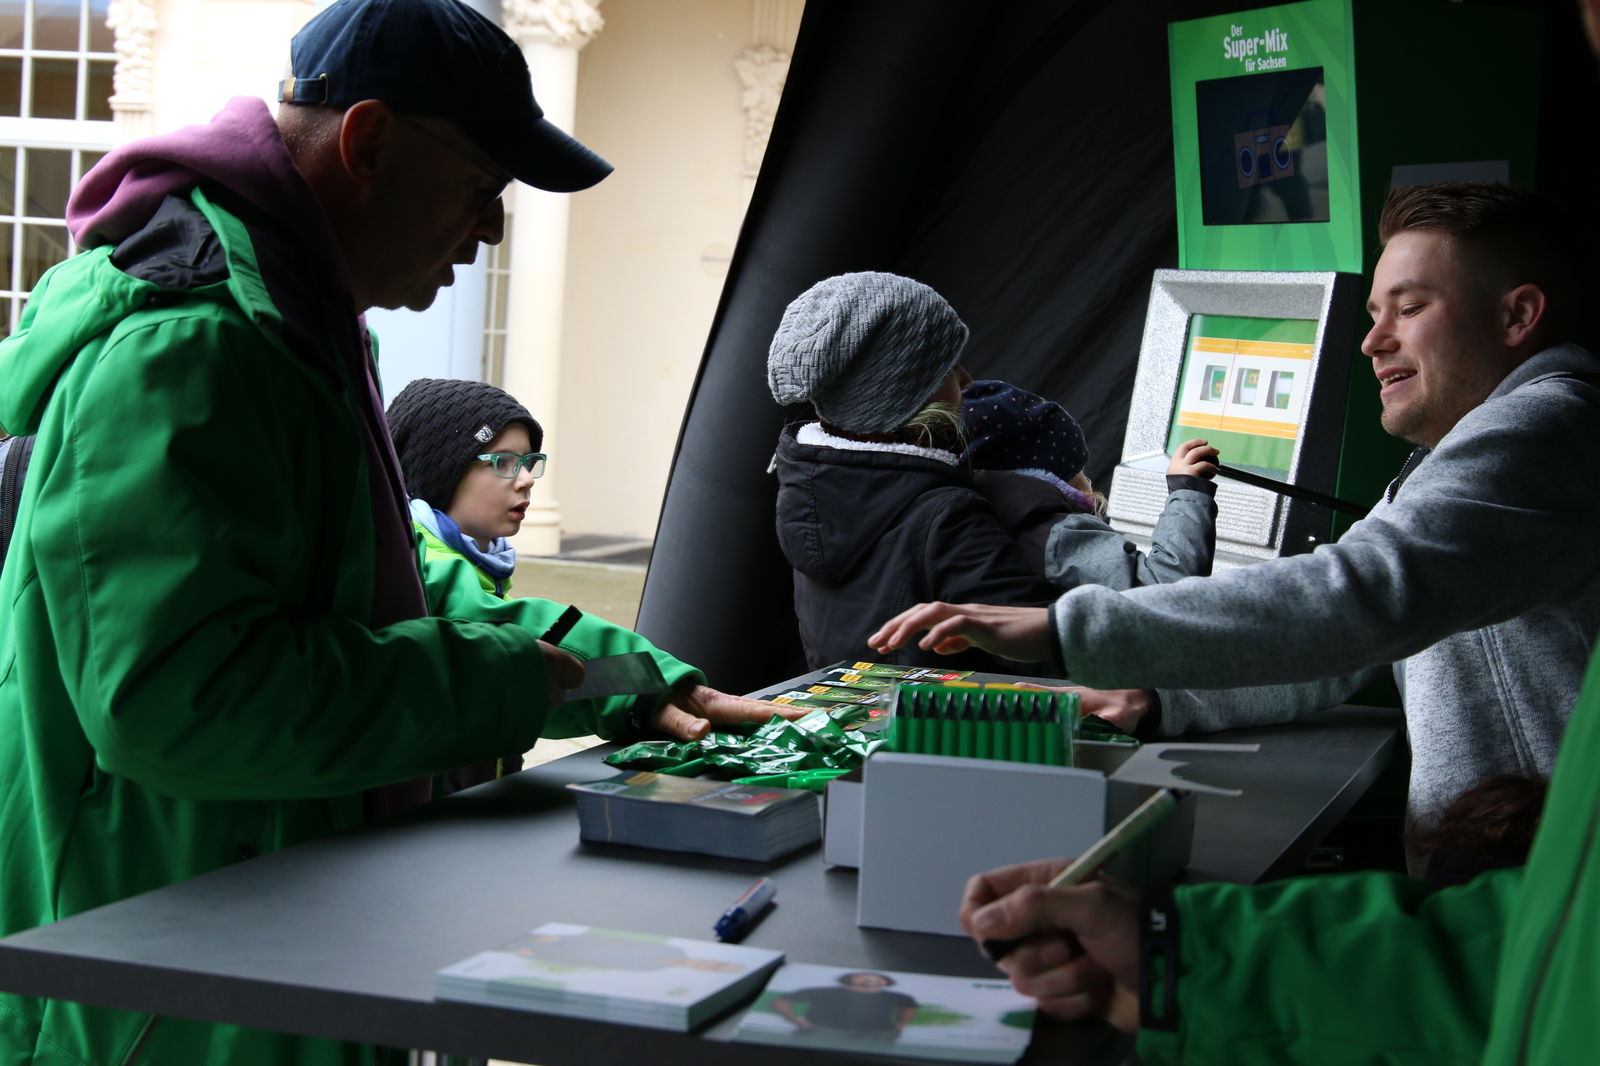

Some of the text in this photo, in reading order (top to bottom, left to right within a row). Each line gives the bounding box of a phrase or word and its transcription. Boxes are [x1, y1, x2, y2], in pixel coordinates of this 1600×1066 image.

[1231, 24, 1243, 37] Der
[1224, 28, 1288, 62] Super-Mix
[1245, 56, 1287, 72] für Sachsen
